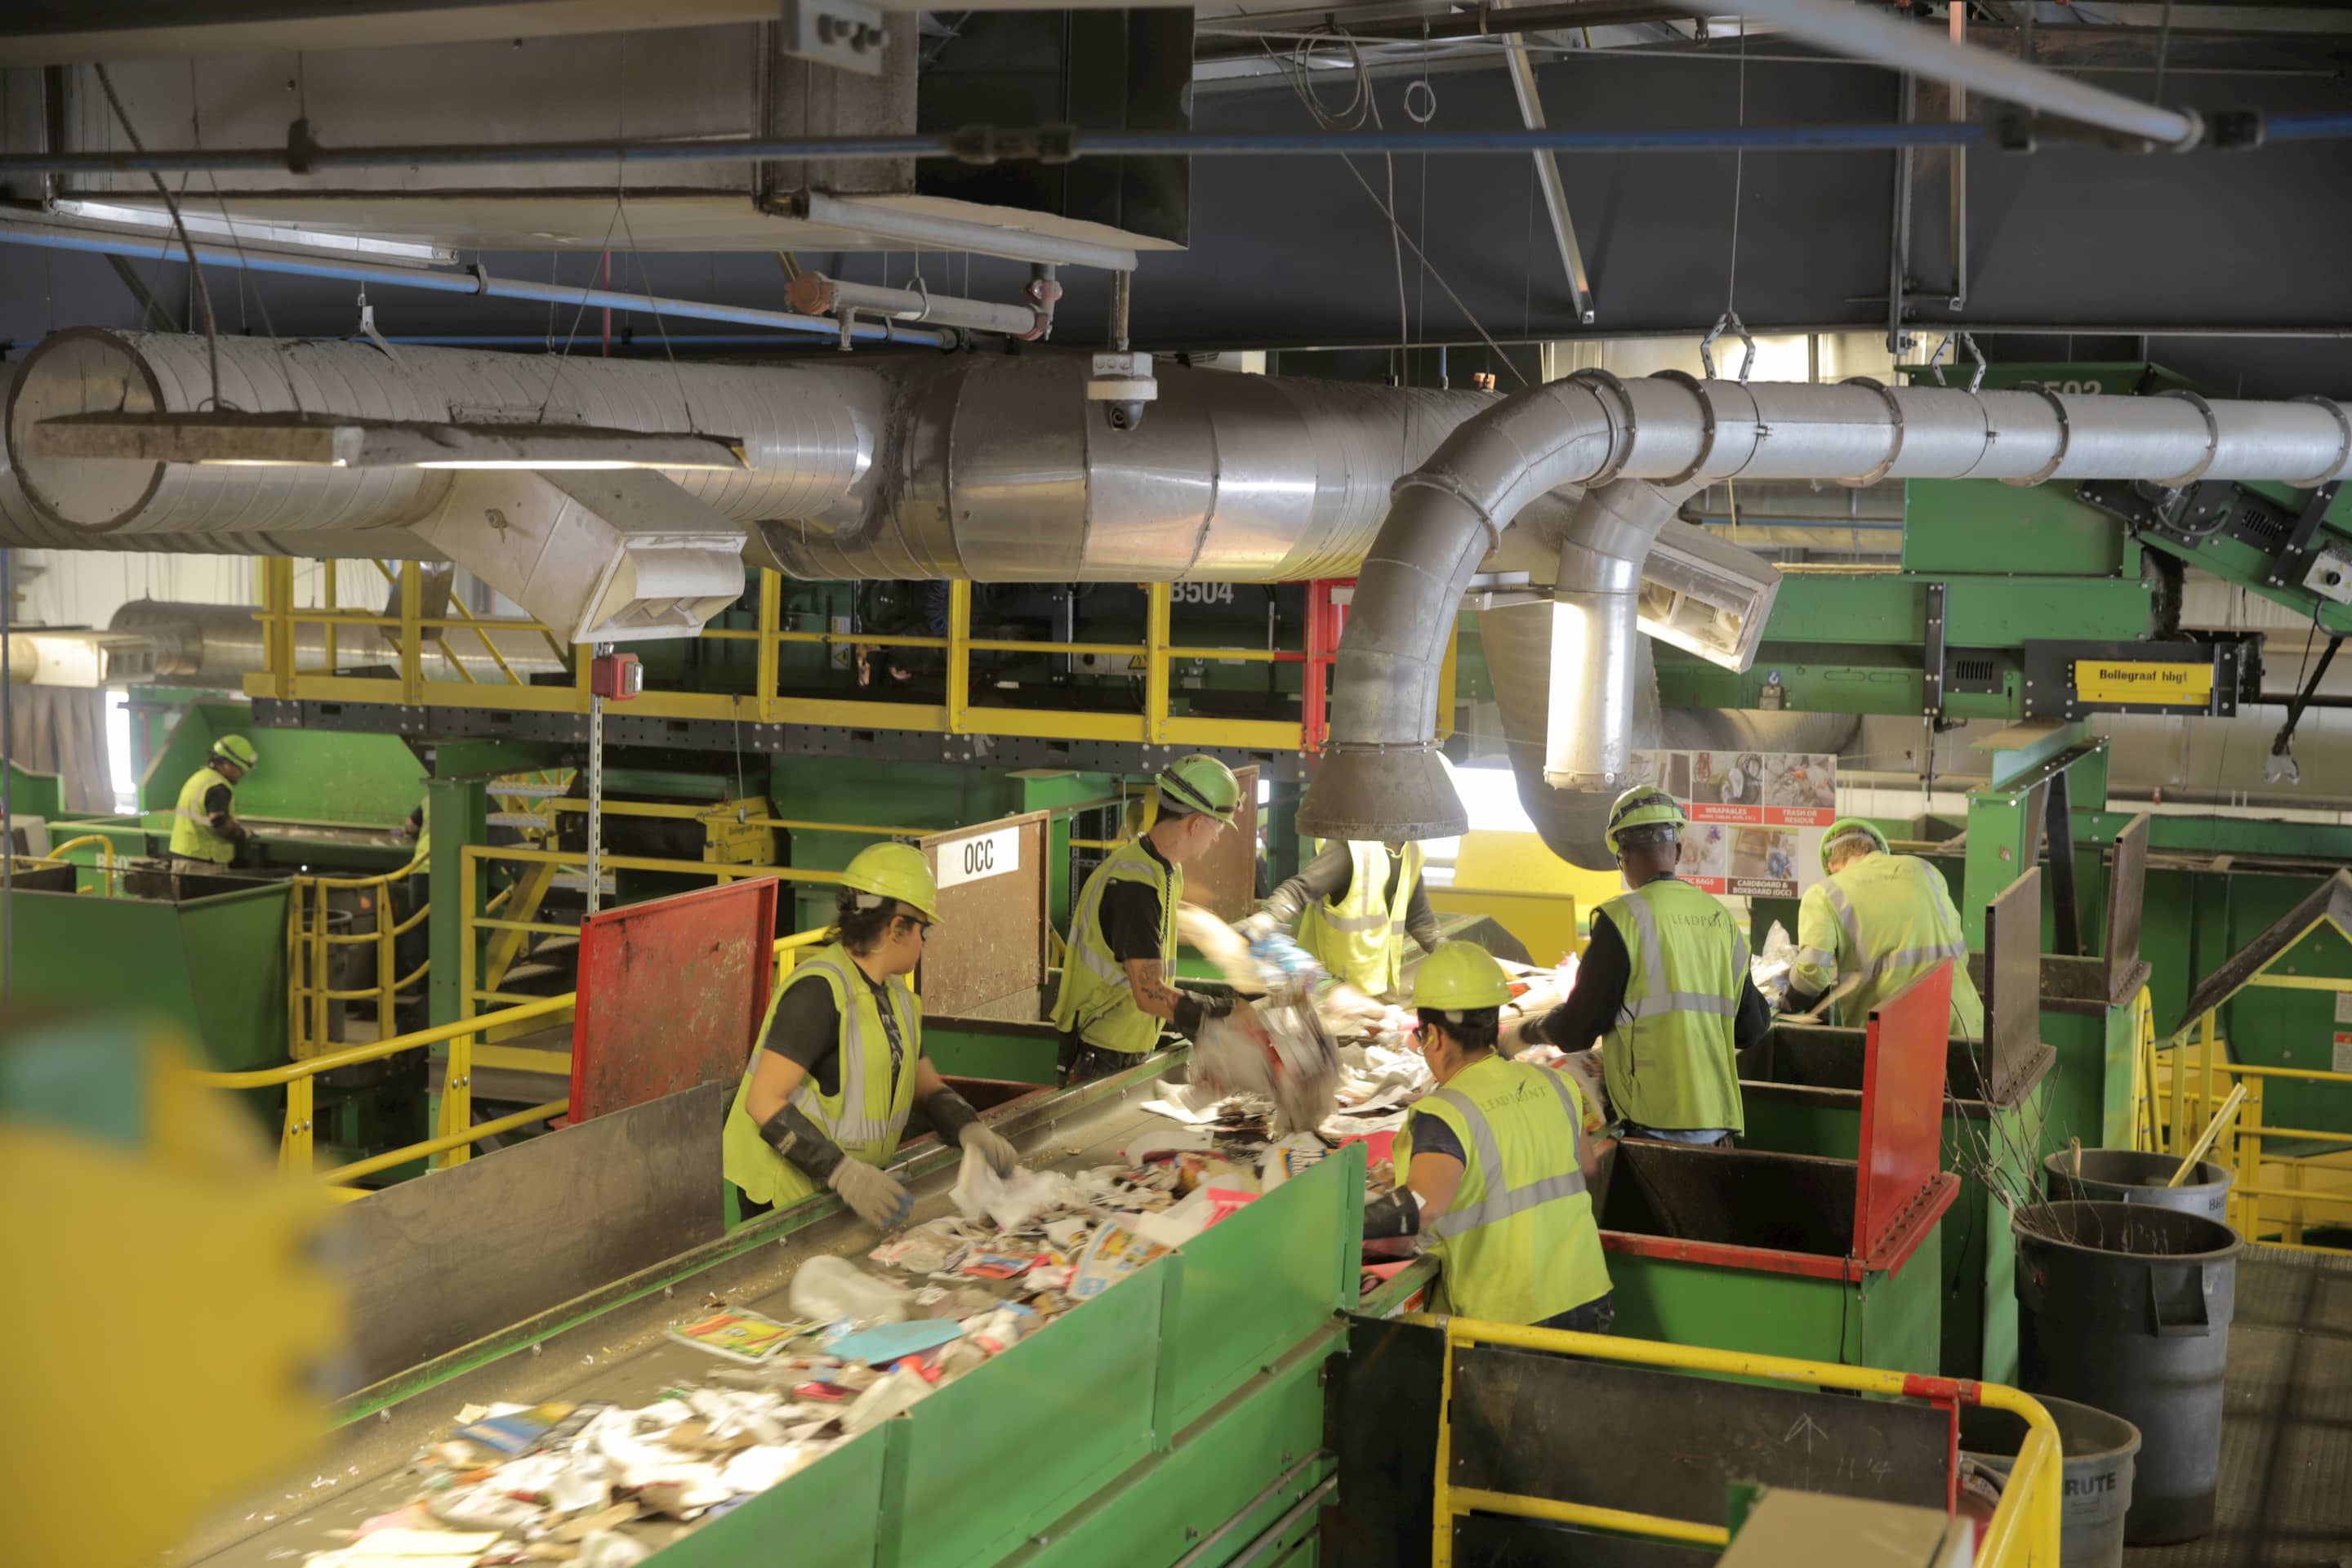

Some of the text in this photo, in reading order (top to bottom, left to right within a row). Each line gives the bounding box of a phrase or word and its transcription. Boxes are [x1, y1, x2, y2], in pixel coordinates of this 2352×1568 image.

[1170, 581, 1235, 604] B504
[2100, 669, 2157, 683] Bollegraaf
[1704, 806, 1748, 816] WRAPABLES
[1783, 808, 1806, 817] TRASH
[964, 839, 994, 875] OCC
[1737, 880, 1781, 889] CARDBOARD
[1733, 888, 1772, 896] BOXBOARD
[2064, 1471, 2117, 1497] RUTE
